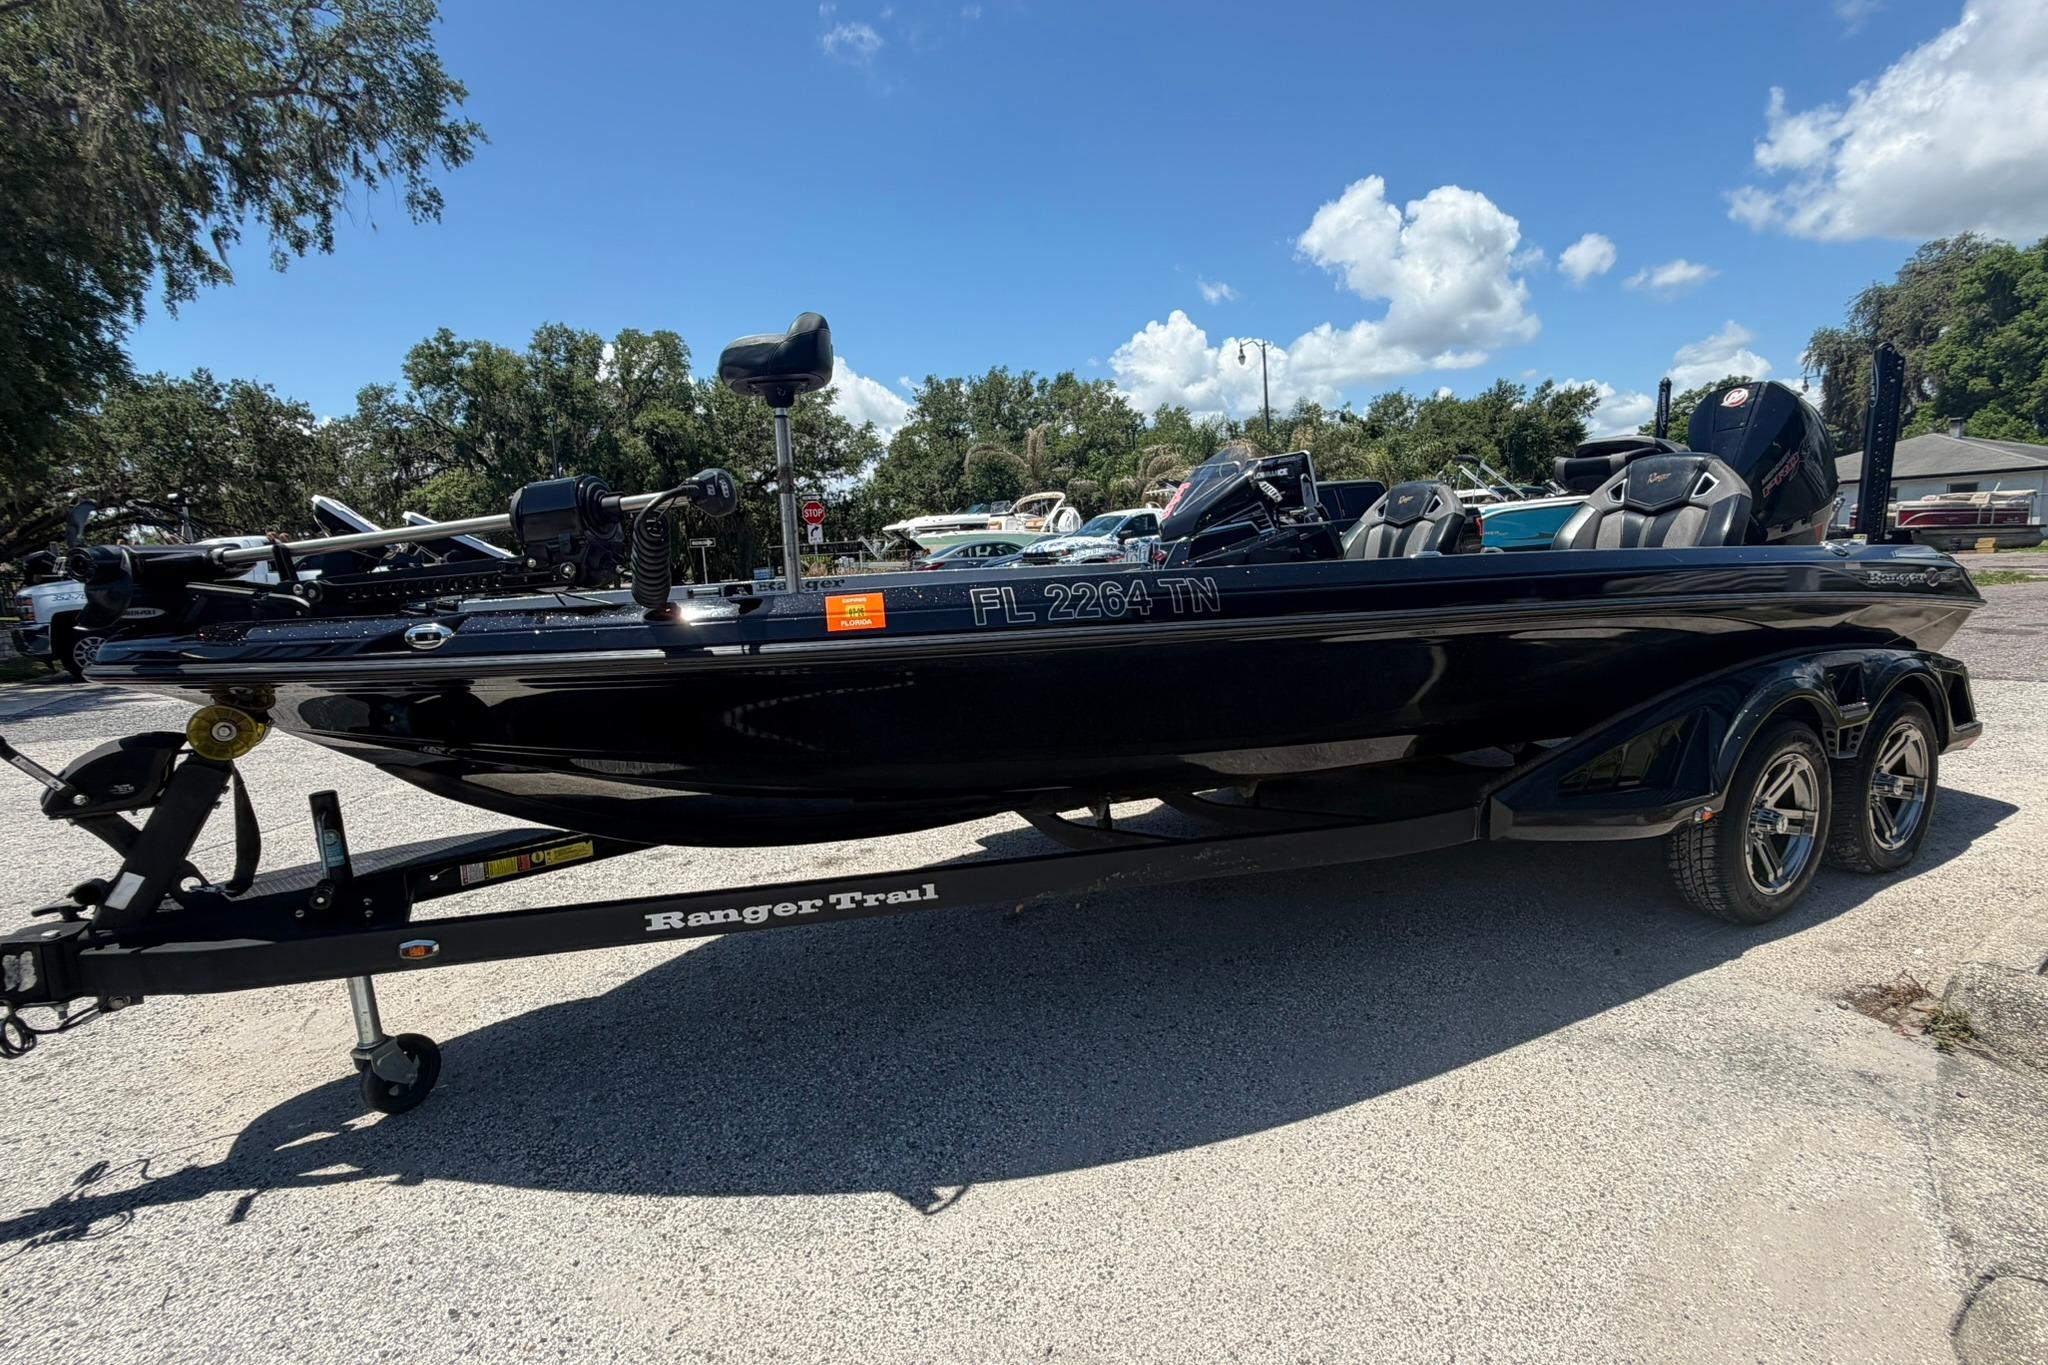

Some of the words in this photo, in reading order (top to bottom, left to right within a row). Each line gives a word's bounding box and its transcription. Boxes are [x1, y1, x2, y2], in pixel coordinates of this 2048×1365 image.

[804, 508, 823, 518] STOP
[756, 579, 845, 592] Rager
[970, 587, 1036, 626] FL
[1044, 582, 1152, 621] 2264
[1157, 577, 1221, 614] TN
[840, 618, 873, 627] FLORIDA
[645, 899, 823, 931] Ranger
[829, 883, 939, 910] Trail
